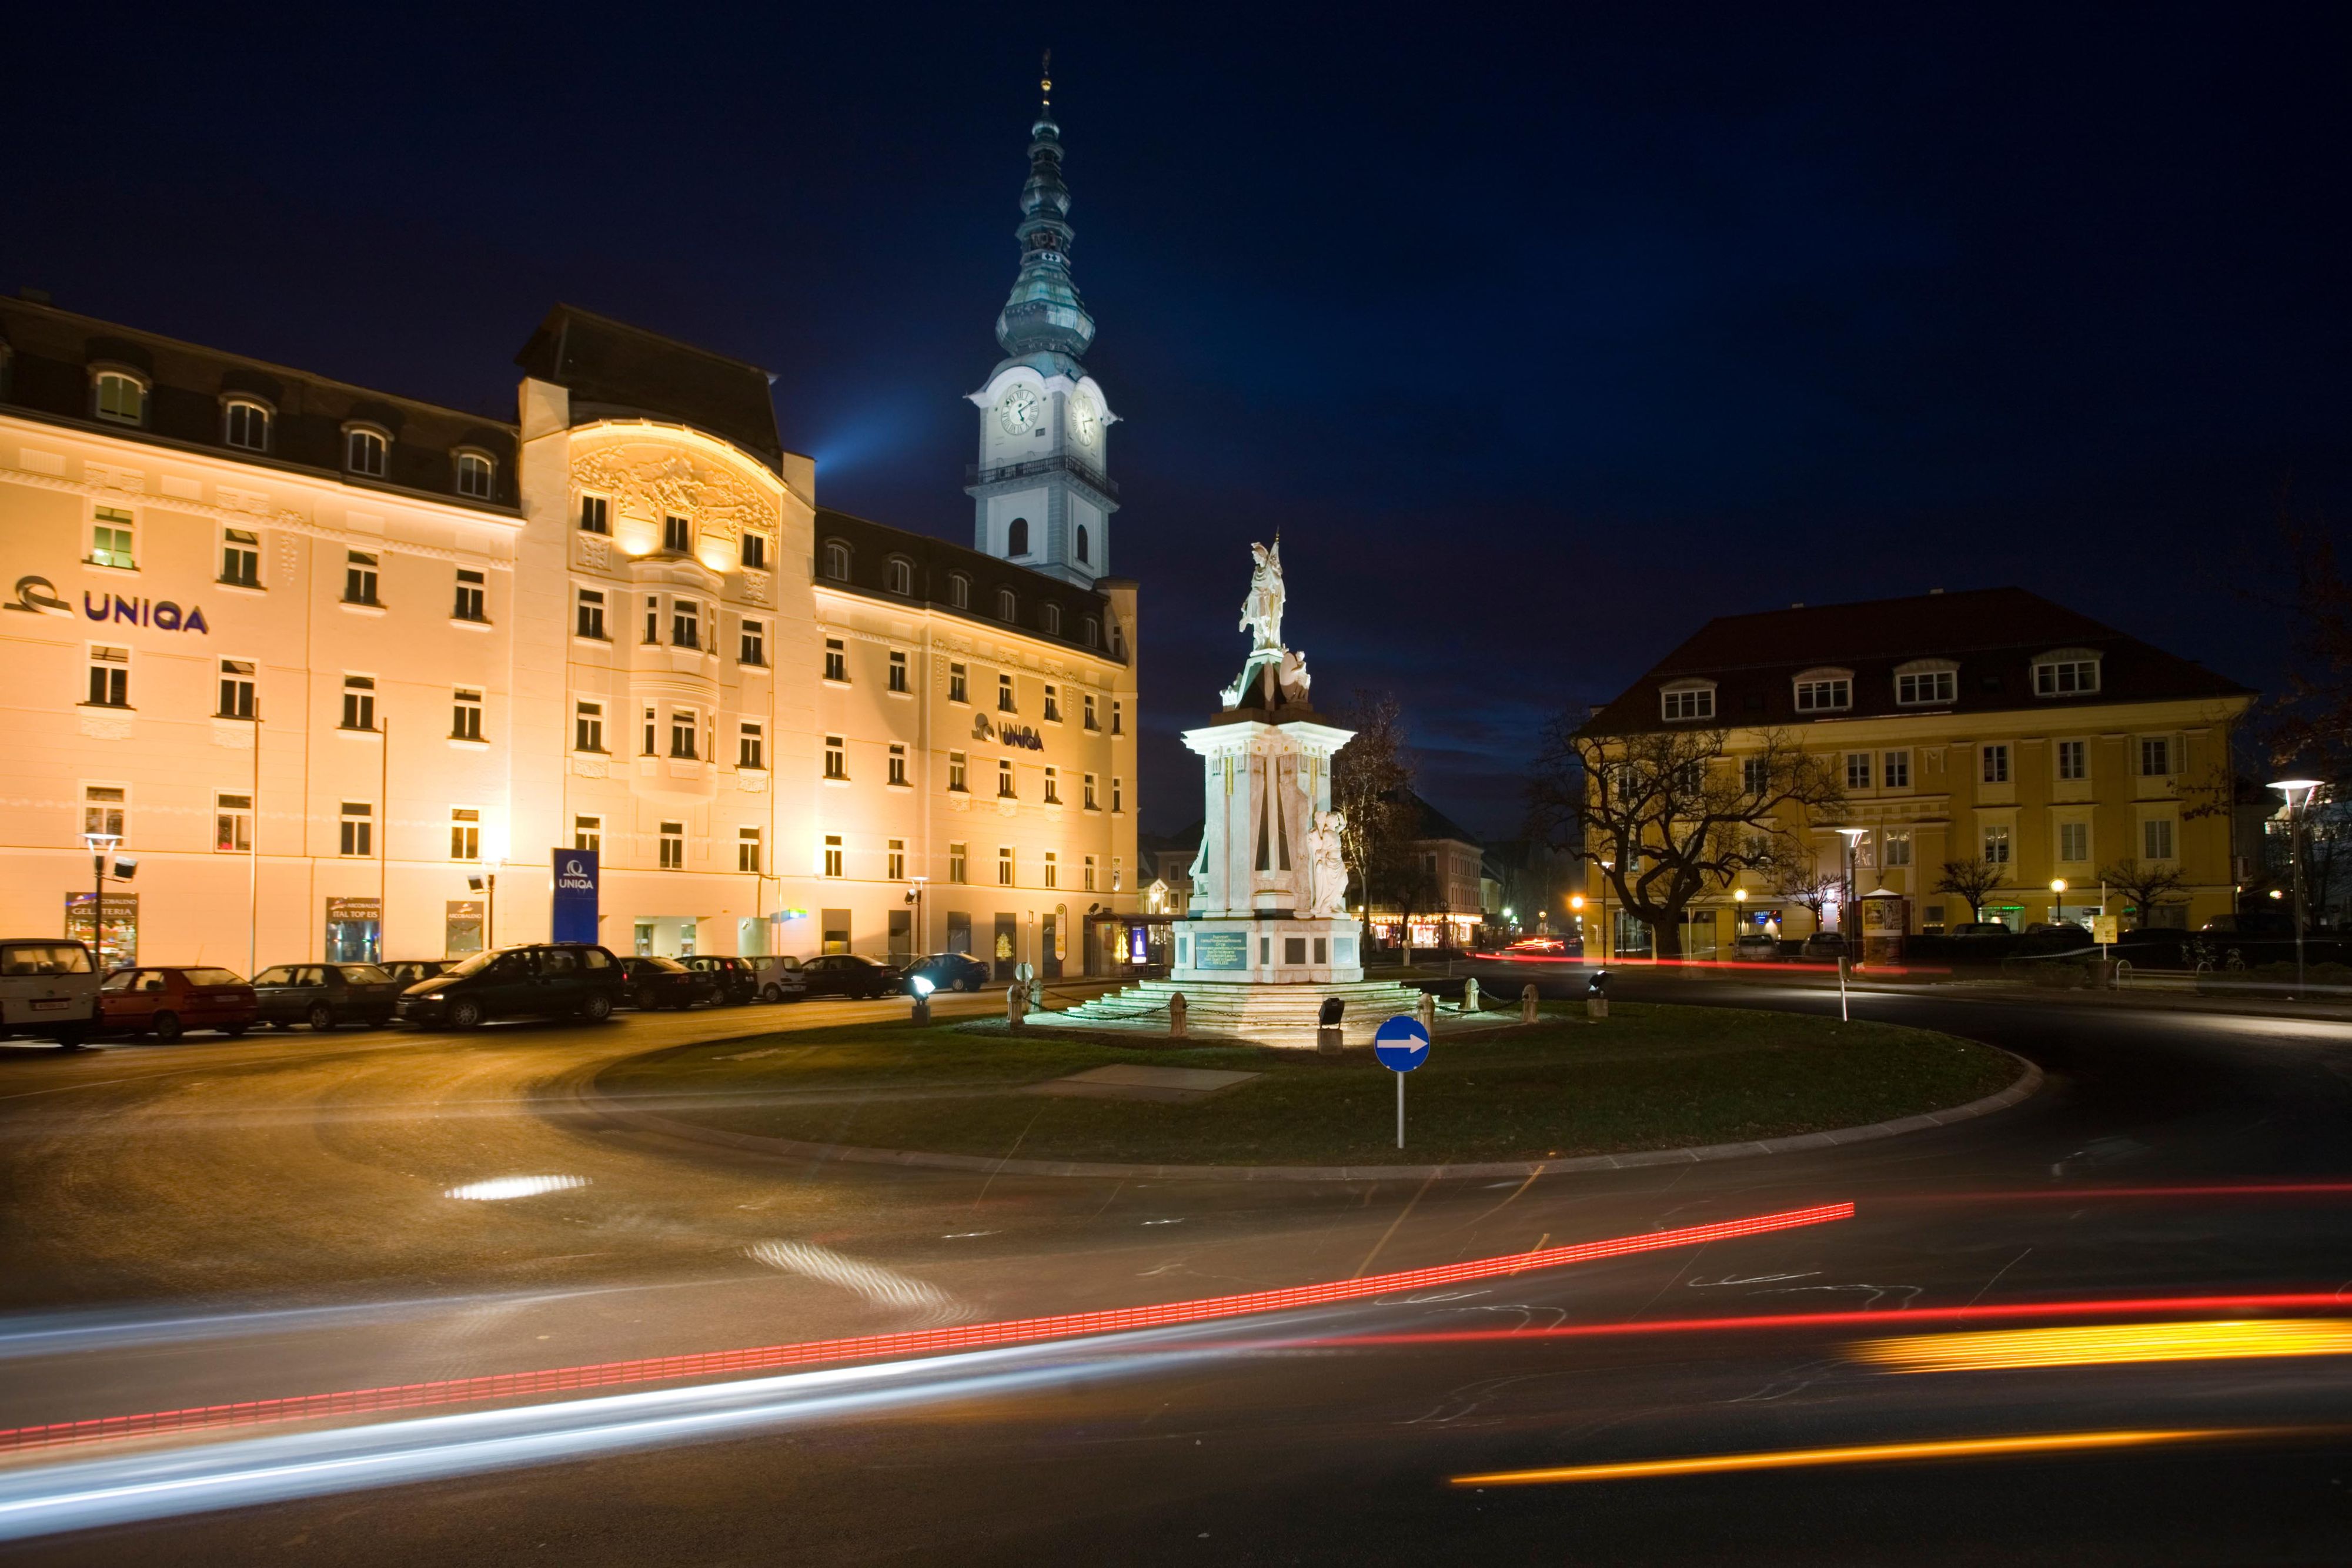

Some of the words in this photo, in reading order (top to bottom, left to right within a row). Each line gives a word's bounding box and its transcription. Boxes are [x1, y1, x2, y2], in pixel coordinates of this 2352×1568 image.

[84, 590, 209, 634] UNIQA
[1002, 729, 1044, 752] UNIQA
[559, 879, 593, 889] UNIQA
